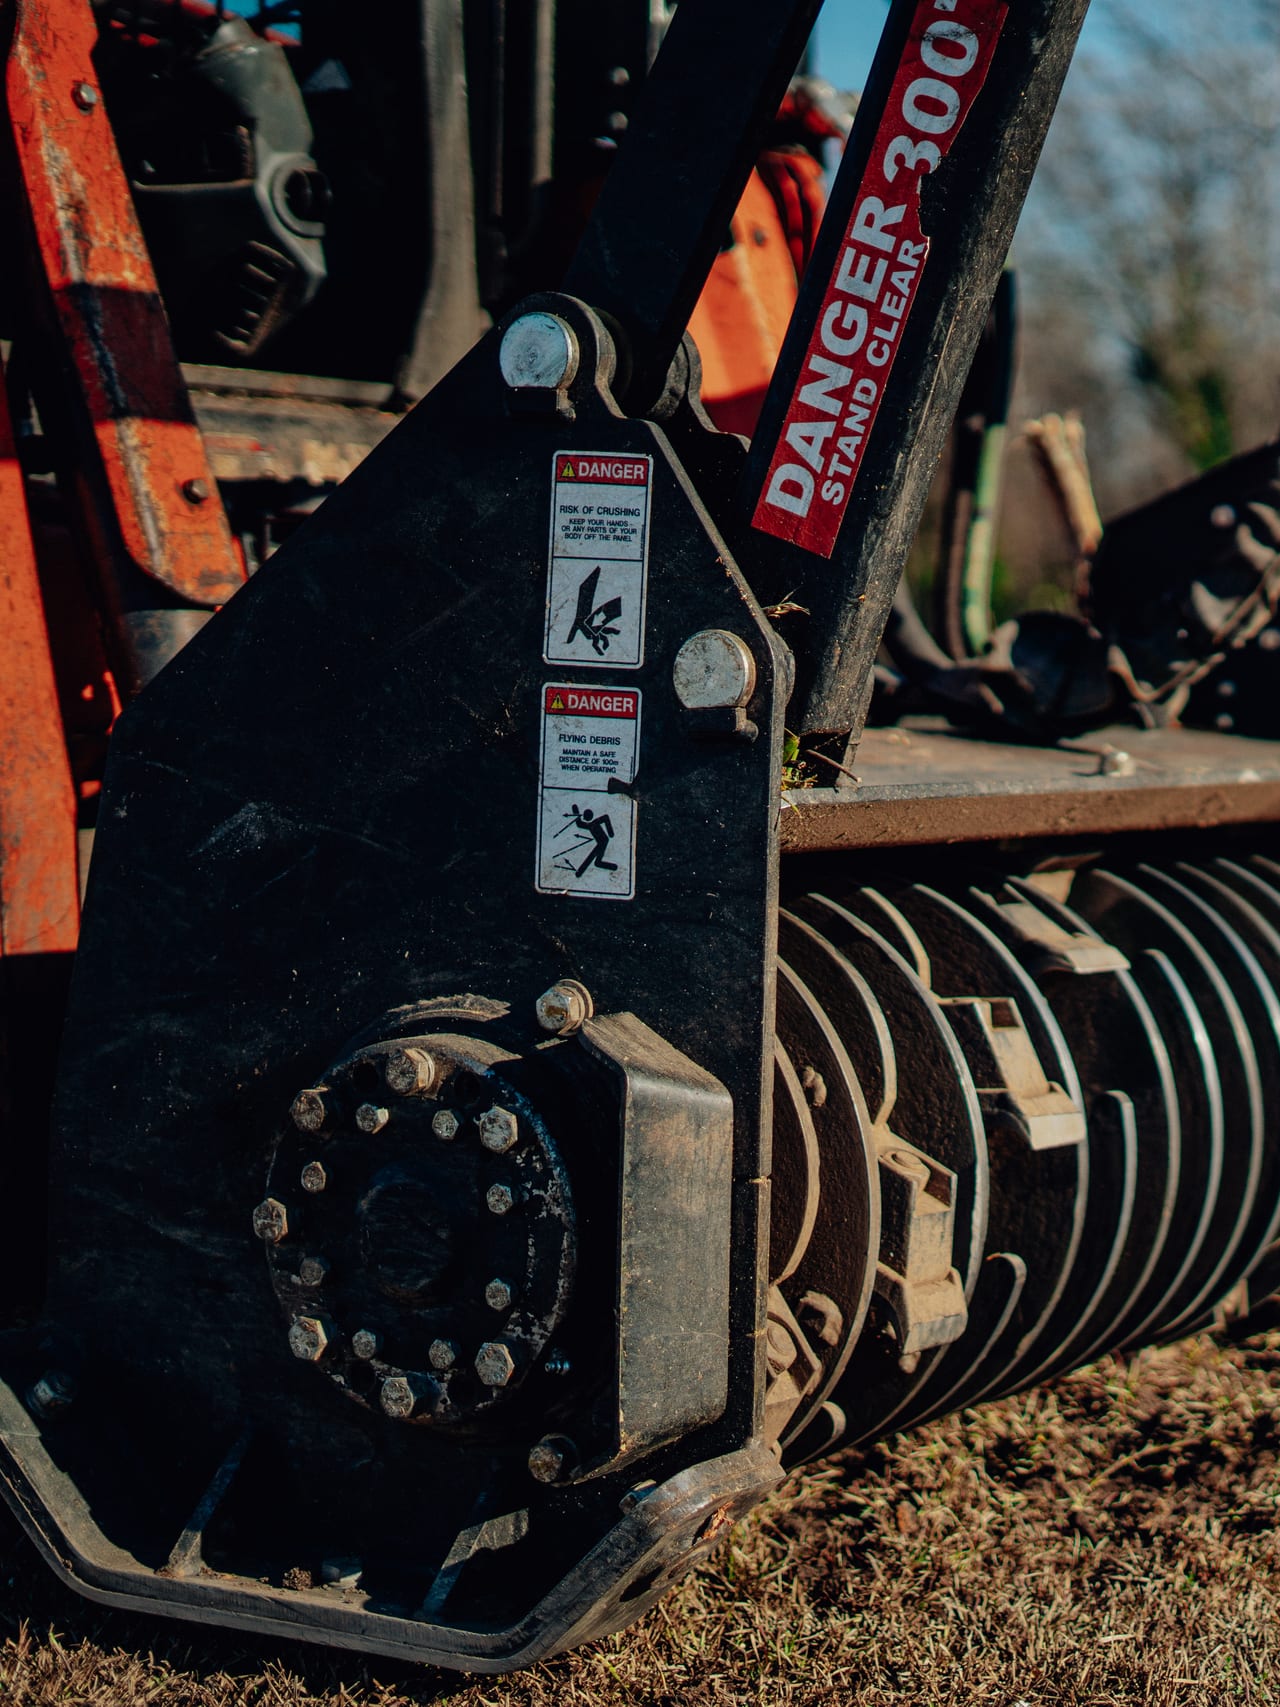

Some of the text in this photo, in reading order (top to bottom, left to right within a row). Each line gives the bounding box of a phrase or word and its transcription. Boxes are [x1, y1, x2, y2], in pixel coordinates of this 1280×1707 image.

[766, 196, 907, 518] DANGER
[821, 239, 926, 506] STAND CLEAR
[578, 462, 644, 480] DANGER
[560, 505, 640, 516] RISK OF CRUSHING
[606, 519, 629, 527] HANDS
[587, 526, 607, 534] PARTS
[620, 527, 637, 535] YOUR
[564, 532, 582, 540] BODY
[584, 533, 597, 541] OFF
[613, 535, 632, 543] PANEL
[567, 694, 634, 713] DANGER
[558, 733, 621, 746] FLYING DEBRIS
[562, 748, 591, 757] MAINTAIN
[559, 756, 589, 765] DISTANCE
[602, 758, 619, 766] 100m
[561, 764, 617, 774] WHEN OPERATING
